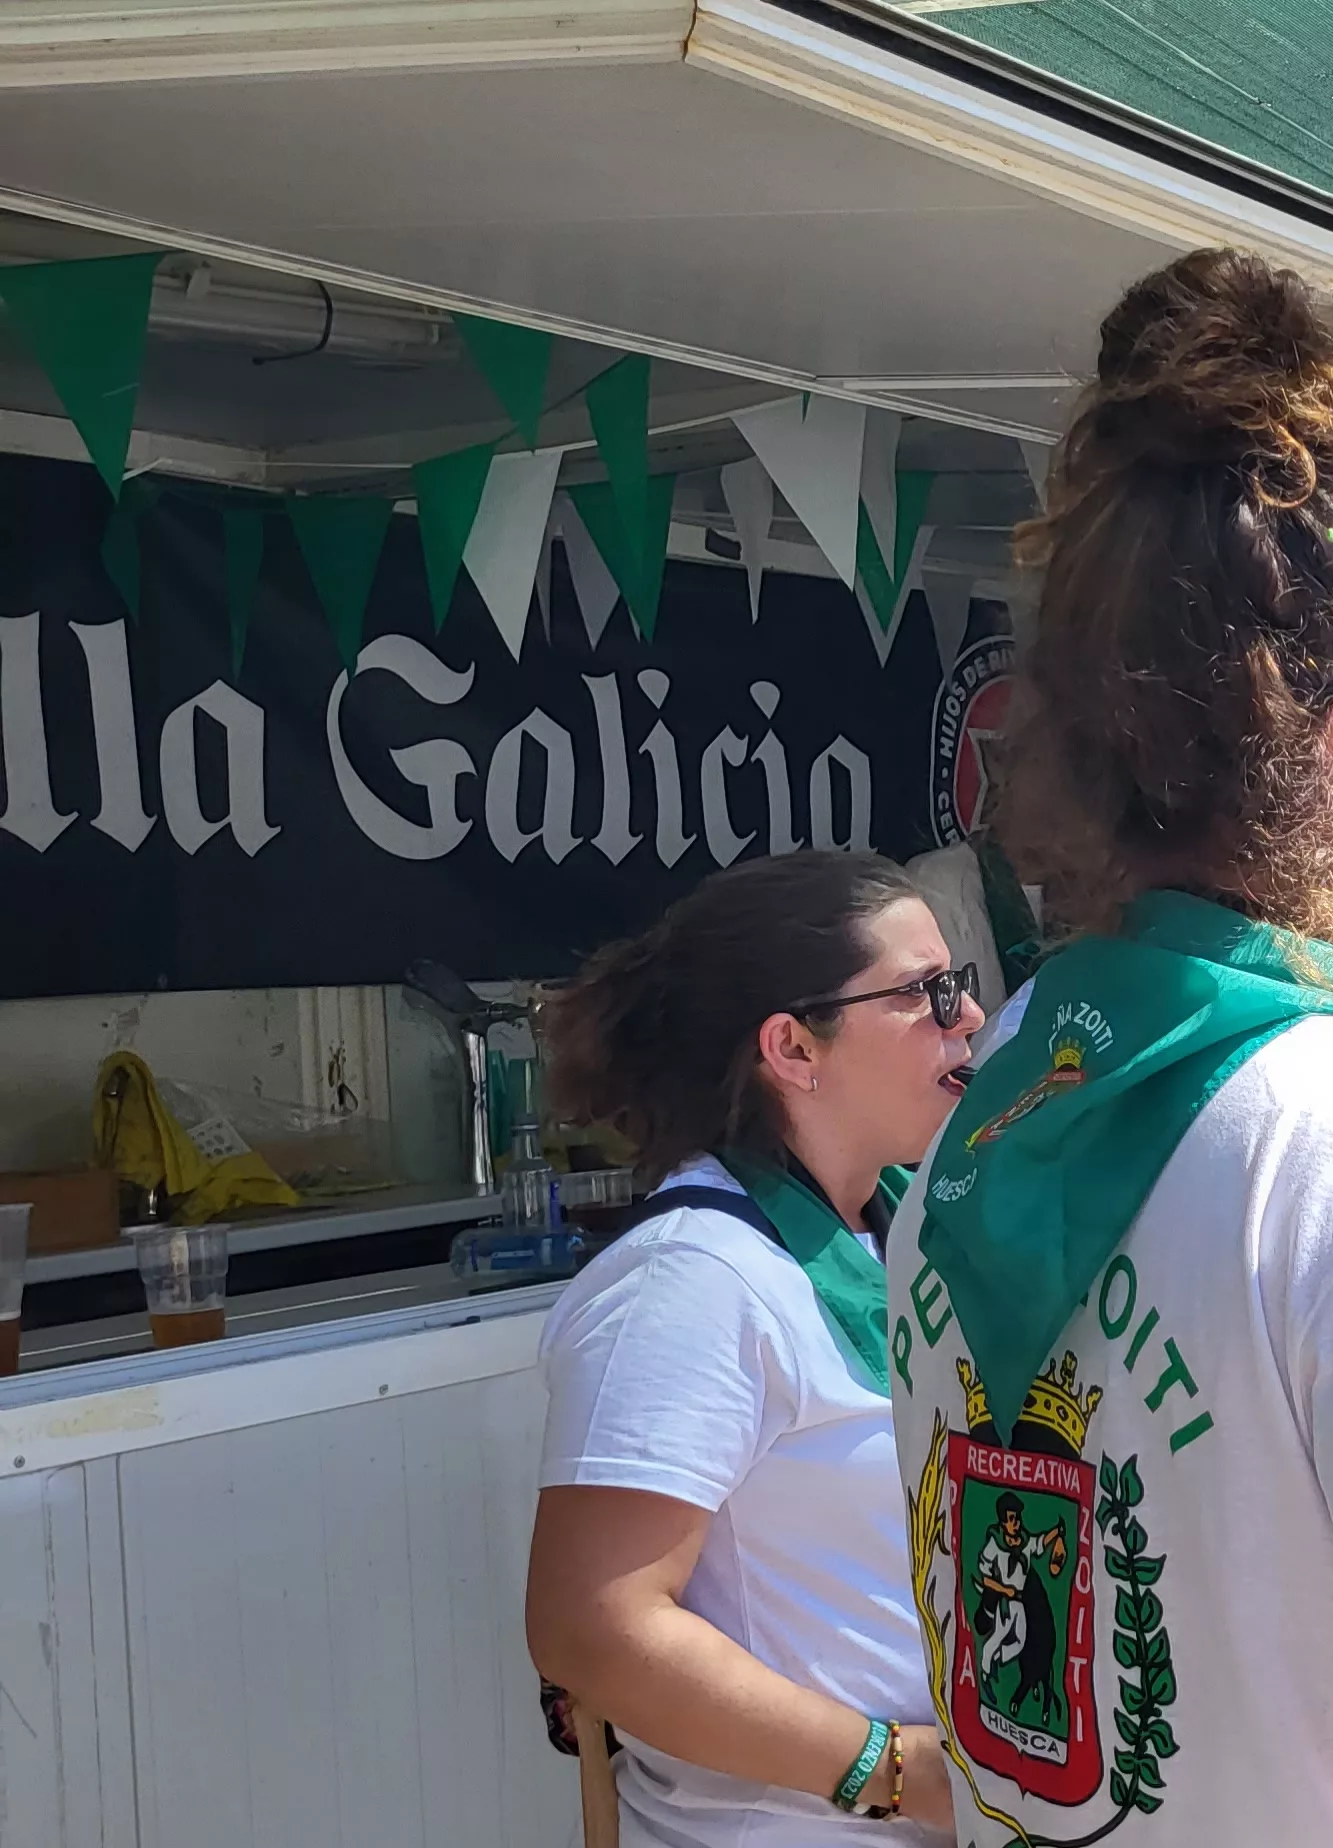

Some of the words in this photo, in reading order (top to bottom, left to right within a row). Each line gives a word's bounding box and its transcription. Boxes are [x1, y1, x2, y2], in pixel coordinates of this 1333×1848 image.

[325, 632, 877, 869] Galicia
[939, 680, 967, 759] HIJOS
[1073, 1000, 1114, 1054] ZOITI
[891, 1257, 954, 1399] PE
[1079, 1253, 1215, 1457] OITI
[966, 1444, 1081, 1495] RECREATIVA
[1068, 1505, 1092, 1743] ZOITI
[987, 1710, 1061, 1758] HUESCA
